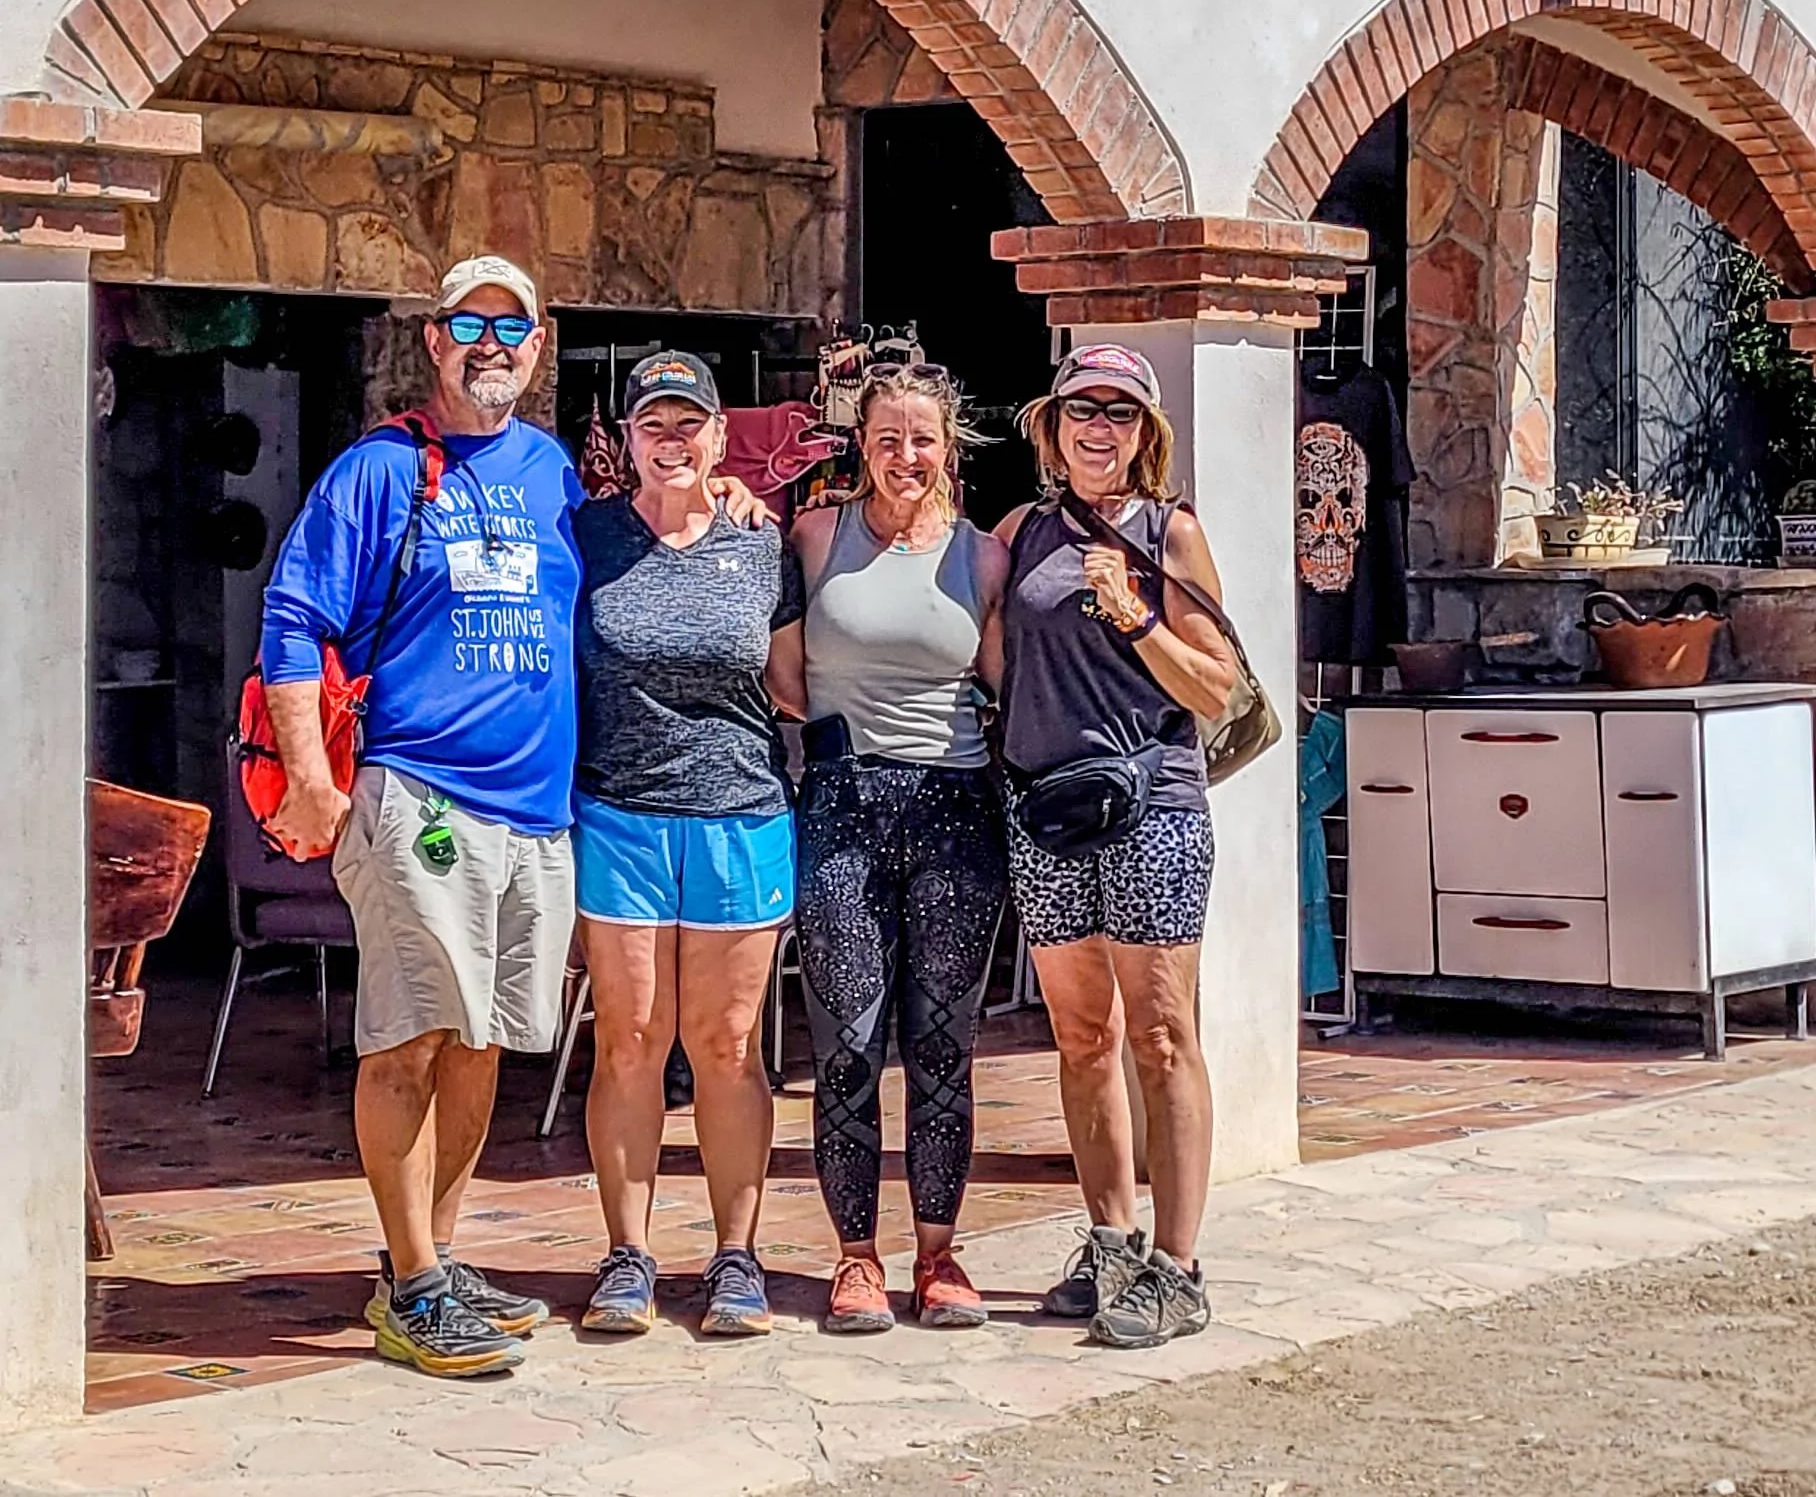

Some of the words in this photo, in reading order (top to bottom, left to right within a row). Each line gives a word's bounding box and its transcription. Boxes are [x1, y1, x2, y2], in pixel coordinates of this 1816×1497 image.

[435, 486, 476, 513] OW
[481, 483, 527, 514] KEY
[455, 642, 550, 673] STRONG
